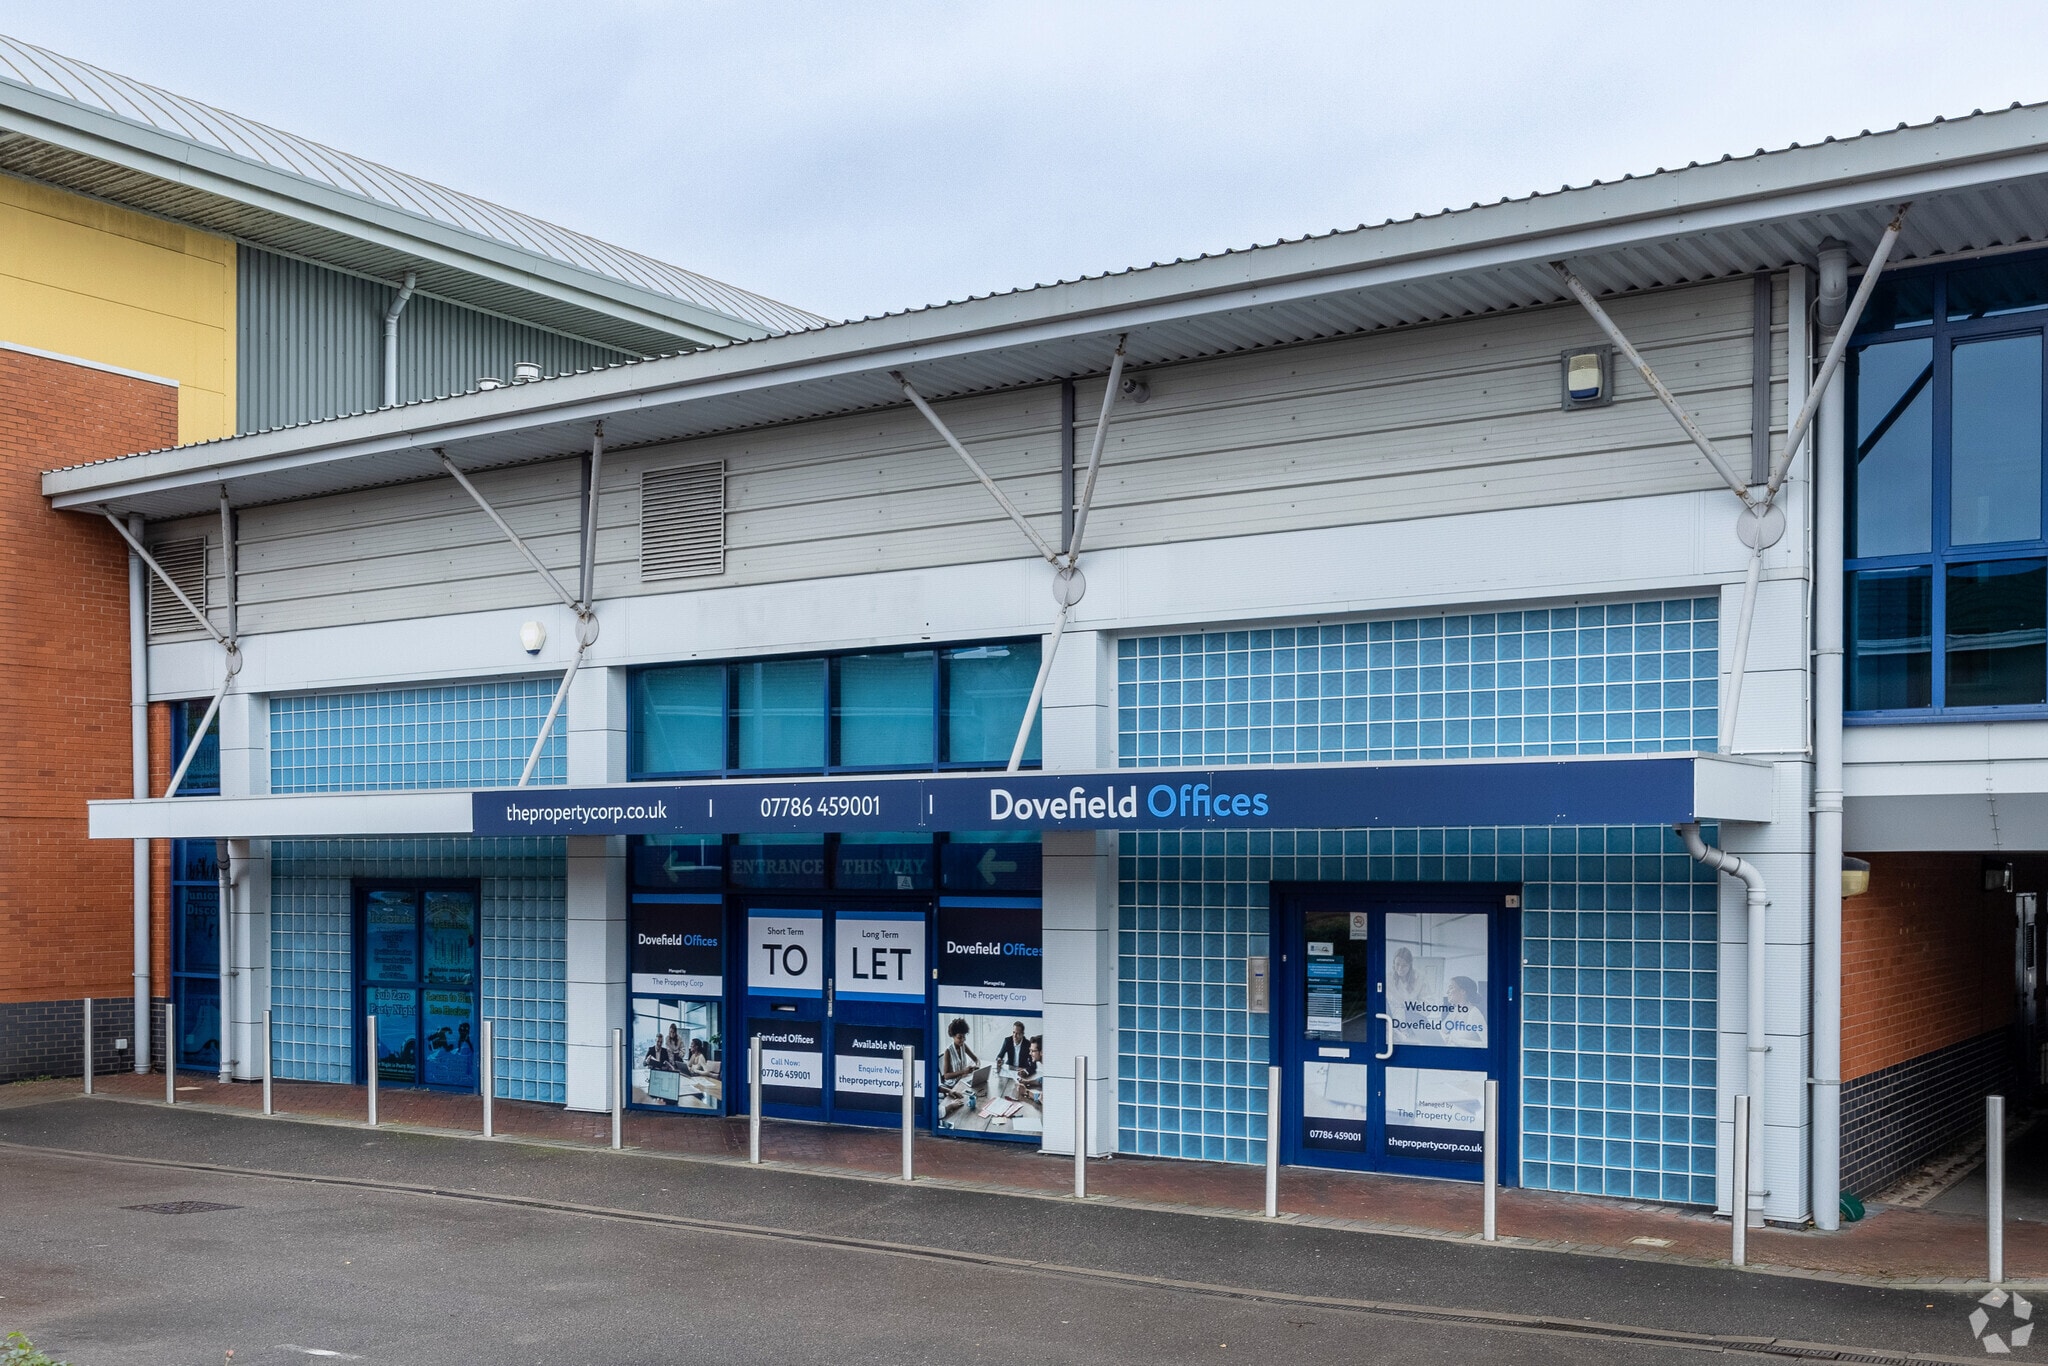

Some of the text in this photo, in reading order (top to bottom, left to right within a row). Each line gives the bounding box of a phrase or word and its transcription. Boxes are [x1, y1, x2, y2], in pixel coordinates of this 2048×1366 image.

[990, 783, 1269, 821] Dovefield Offices
[507, 800, 667, 825] thepropertycorp.co.uk
[760, 796, 881, 825] 07786 459001
[732, 858, 925, 875] ENTRANCE THIS WAY
[186, 904, 217, 916] Disco
[767, 927, 804, 936] Short Term
[862, 930, 899, 940] Long Term
[638, 933, 718, 946] Dovefield Offices
[947, 941, 1043, 957] Dovefield Offices
[762, 944, 808, 976] TO
[852, 947, 912, 981] LET
[665, 978, 688, 988] Property
[690, 979, 704, 988] Corp
[376, 990, 411, 1001] Sub Zero
[963, 990, 1027, 1002] The Property Corp
[370, 1003, 416, 1018] Party Night
[1404, 1001, 1469, 1013] Welcome to
[1392, 1018, 1484, 1032] Dovefield Offices
[756, 1033, 814, 1045] Serviced Offices
[852, 1039, 887, 1051] Available
[770, 1058, 801, 1067] Call Now:
[761, 1069, 811, 1080] 07786 459001
[858, 1064, 884, 1074] Enquire
[838, 1075, 922, 1089] thepropertycorp.uk
[1419, 1100, 1454, 1109] Managed by
[1397, 1108, 1476, 1123] The Property Corp
[1309, 1130, 1361, 1142] 07786 459001
[1388, 1136, 1483, 1153] thepropertycorp.co.uk
